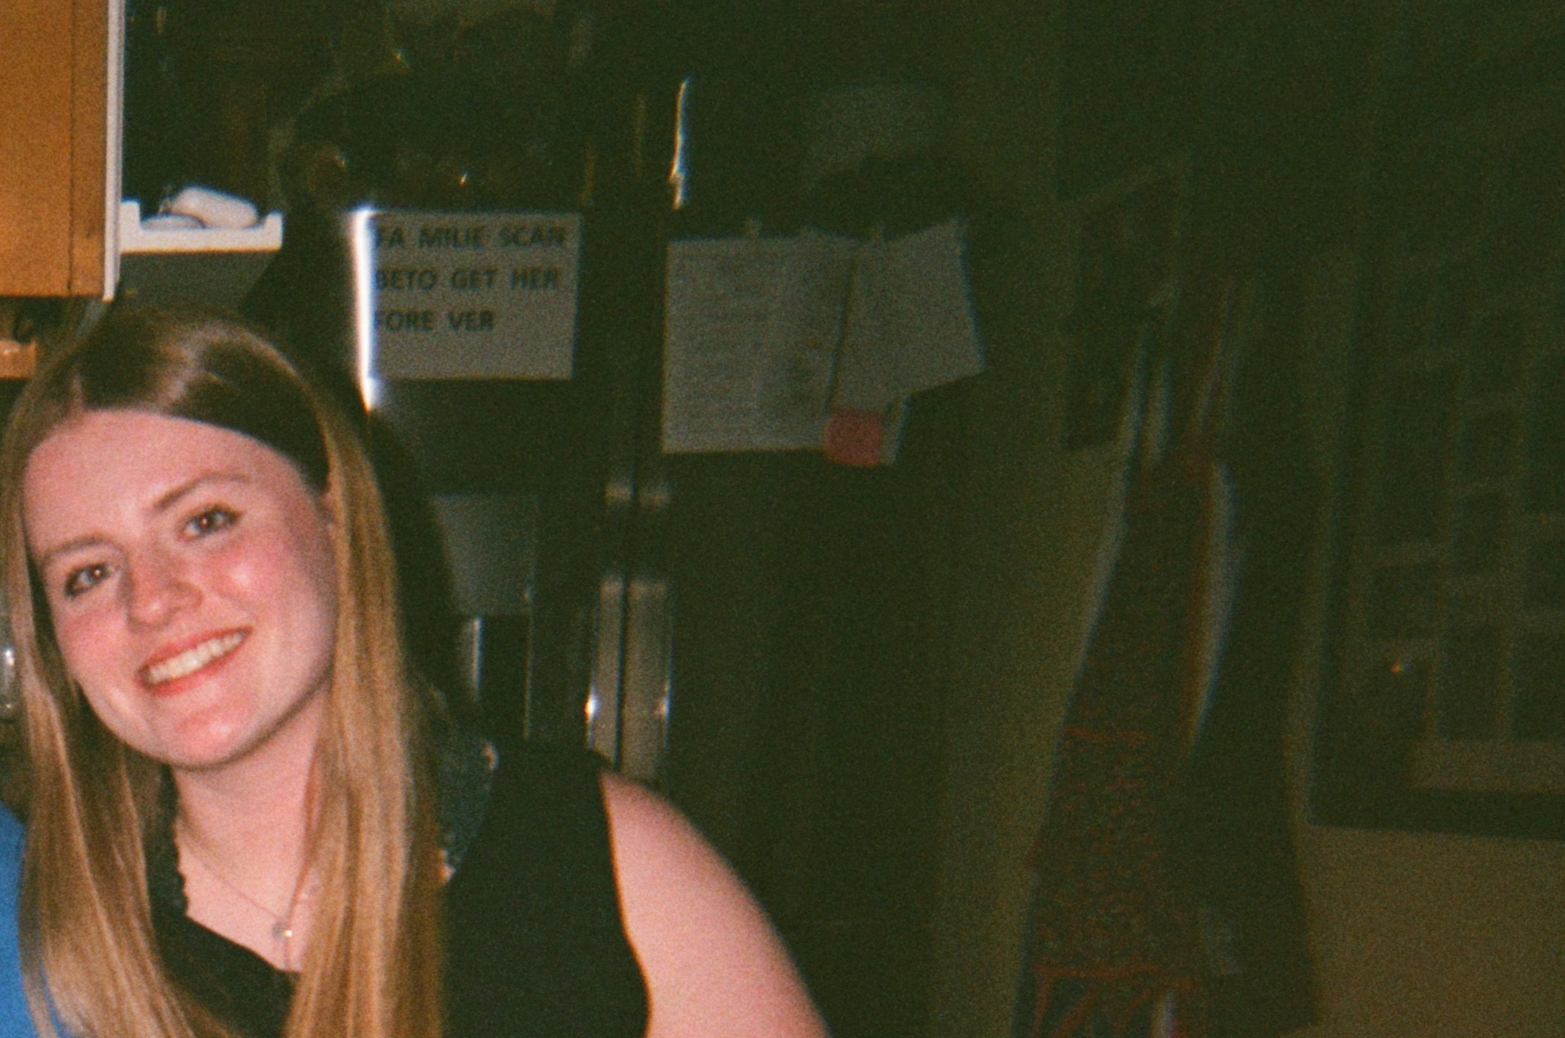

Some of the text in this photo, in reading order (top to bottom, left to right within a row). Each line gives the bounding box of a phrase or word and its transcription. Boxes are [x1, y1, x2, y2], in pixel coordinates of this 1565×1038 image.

[375, 225, 565, 249] FA MILIE SCAN
[374, 268, 559, 291] BETO GET HER
[373, 310, 494, 333] FORE VER
